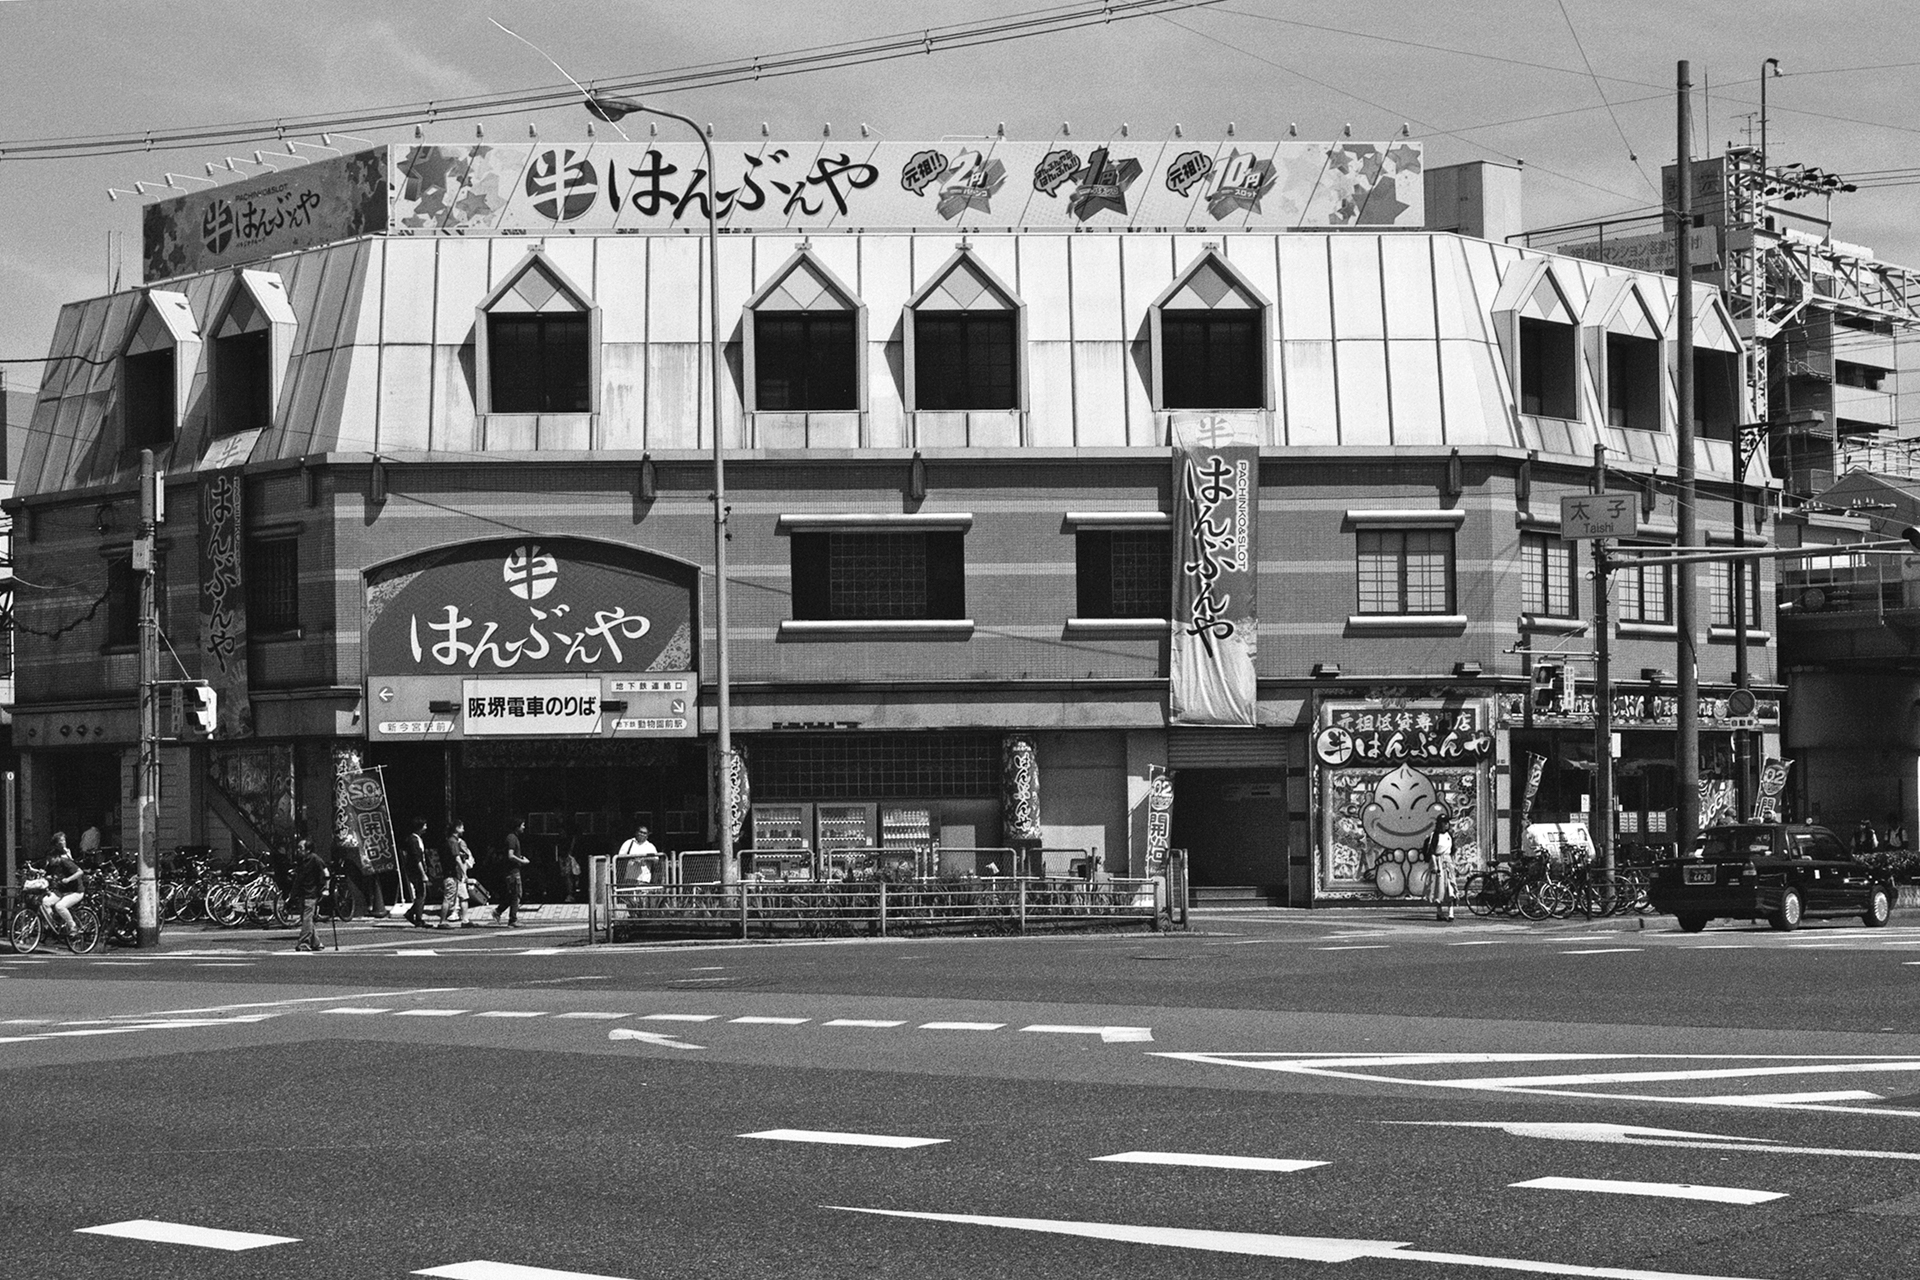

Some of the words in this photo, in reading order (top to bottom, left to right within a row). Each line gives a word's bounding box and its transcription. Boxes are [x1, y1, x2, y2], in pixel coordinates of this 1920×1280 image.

[608, 149, 879, 220] はんぶんや
[904, 152, 942, 188] 元祖!!
[1169, 152, 1207, 188] 元祖!!
[1234, 188, 1258, 198] スロット
[236, 189, 320, 239] はんぶんや
[1237, 461, 1248, 570] PACHINKO&SLOT
[1571, 501, 1626, 520] 太子
[1583, 523, 1614, 534] Taishi
[204, 476, 237, 674] はんぶんや
[1184, 457, 1235, 659] はんぶんや
[410, 603, 651, 669] はんぶんや
[616, 682, 682, 690] 地下鉄連絡口
[468, 696, 597, 719] 阪堺電車のりば
[1336, 712, 1473, 732] 元祖低貸専門店
[387, 722, 446, 732] 新今宮駅前
[1354, 730, 1492, 759] はんぶんや
[1013, 752, 1032, 831] はんぶんや
